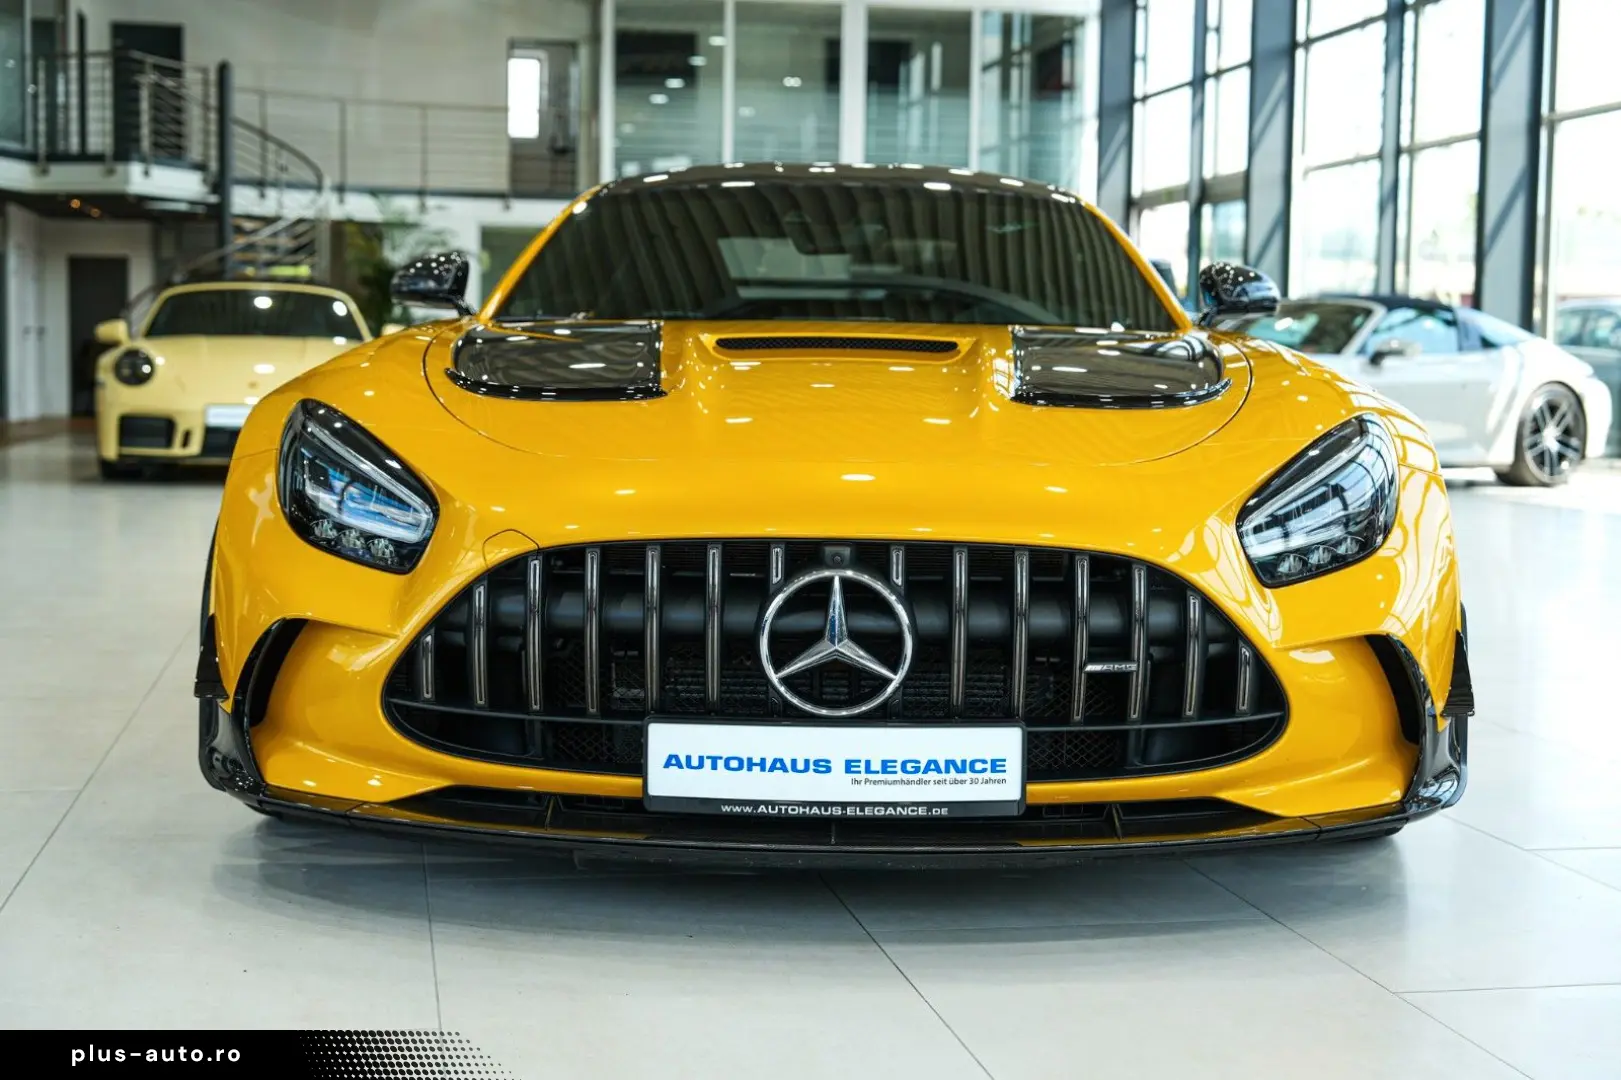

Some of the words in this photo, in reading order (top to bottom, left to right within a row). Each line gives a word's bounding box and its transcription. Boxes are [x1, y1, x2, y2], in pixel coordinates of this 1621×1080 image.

[663, 754, 832, 774] AUTOHAUS
[844, 758, 1007, 775] ELEGANCE
[864, 777, 931, 786] Premiumhändler
[949, 777, 967, 785] über
[980, 777, 1007, 785] Jahren
